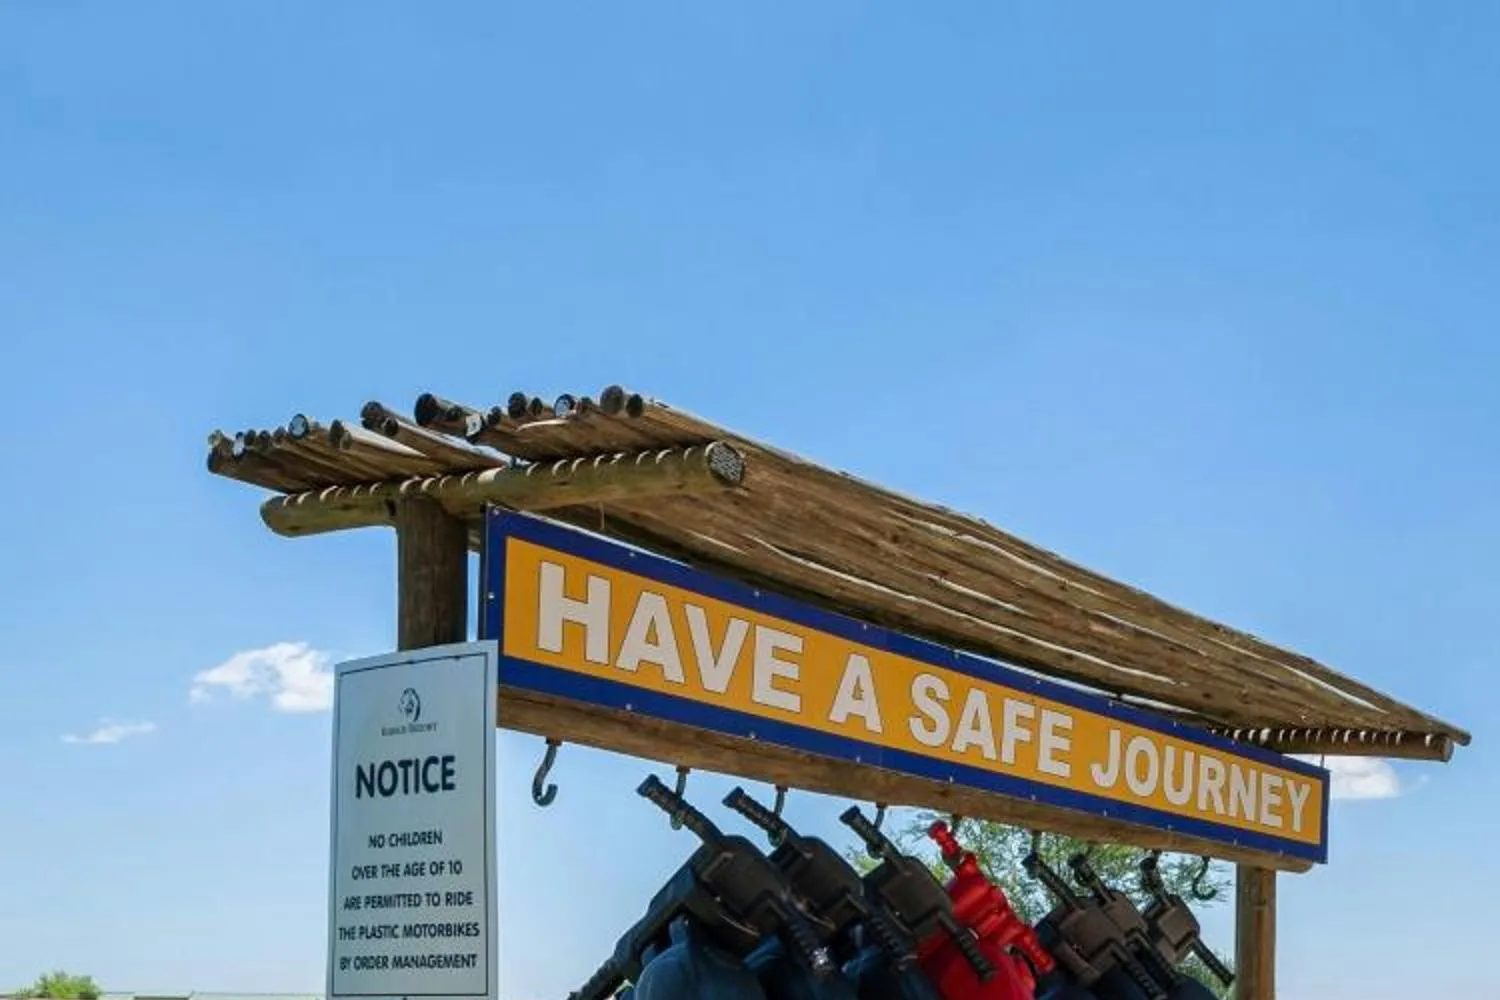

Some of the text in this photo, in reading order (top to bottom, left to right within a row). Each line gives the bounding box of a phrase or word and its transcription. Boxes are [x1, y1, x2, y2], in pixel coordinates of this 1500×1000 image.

[537, 560, 1312, 832] HAVE A SAFE JOURNEY
[356, 754, 456, 799] NOTICE
[368, 830, 443, 848] NO CHILDREN
[351, 860, 463, 880] OVER THE AGE OF 10
[343, 891, 473, 910] ARE PERMITTED TO RIDE
[338, 922, 480, 940] THE PLASTIC MOTORBIKES
[340, 953, 477, 971] BY ORDER MANAGEMENT
